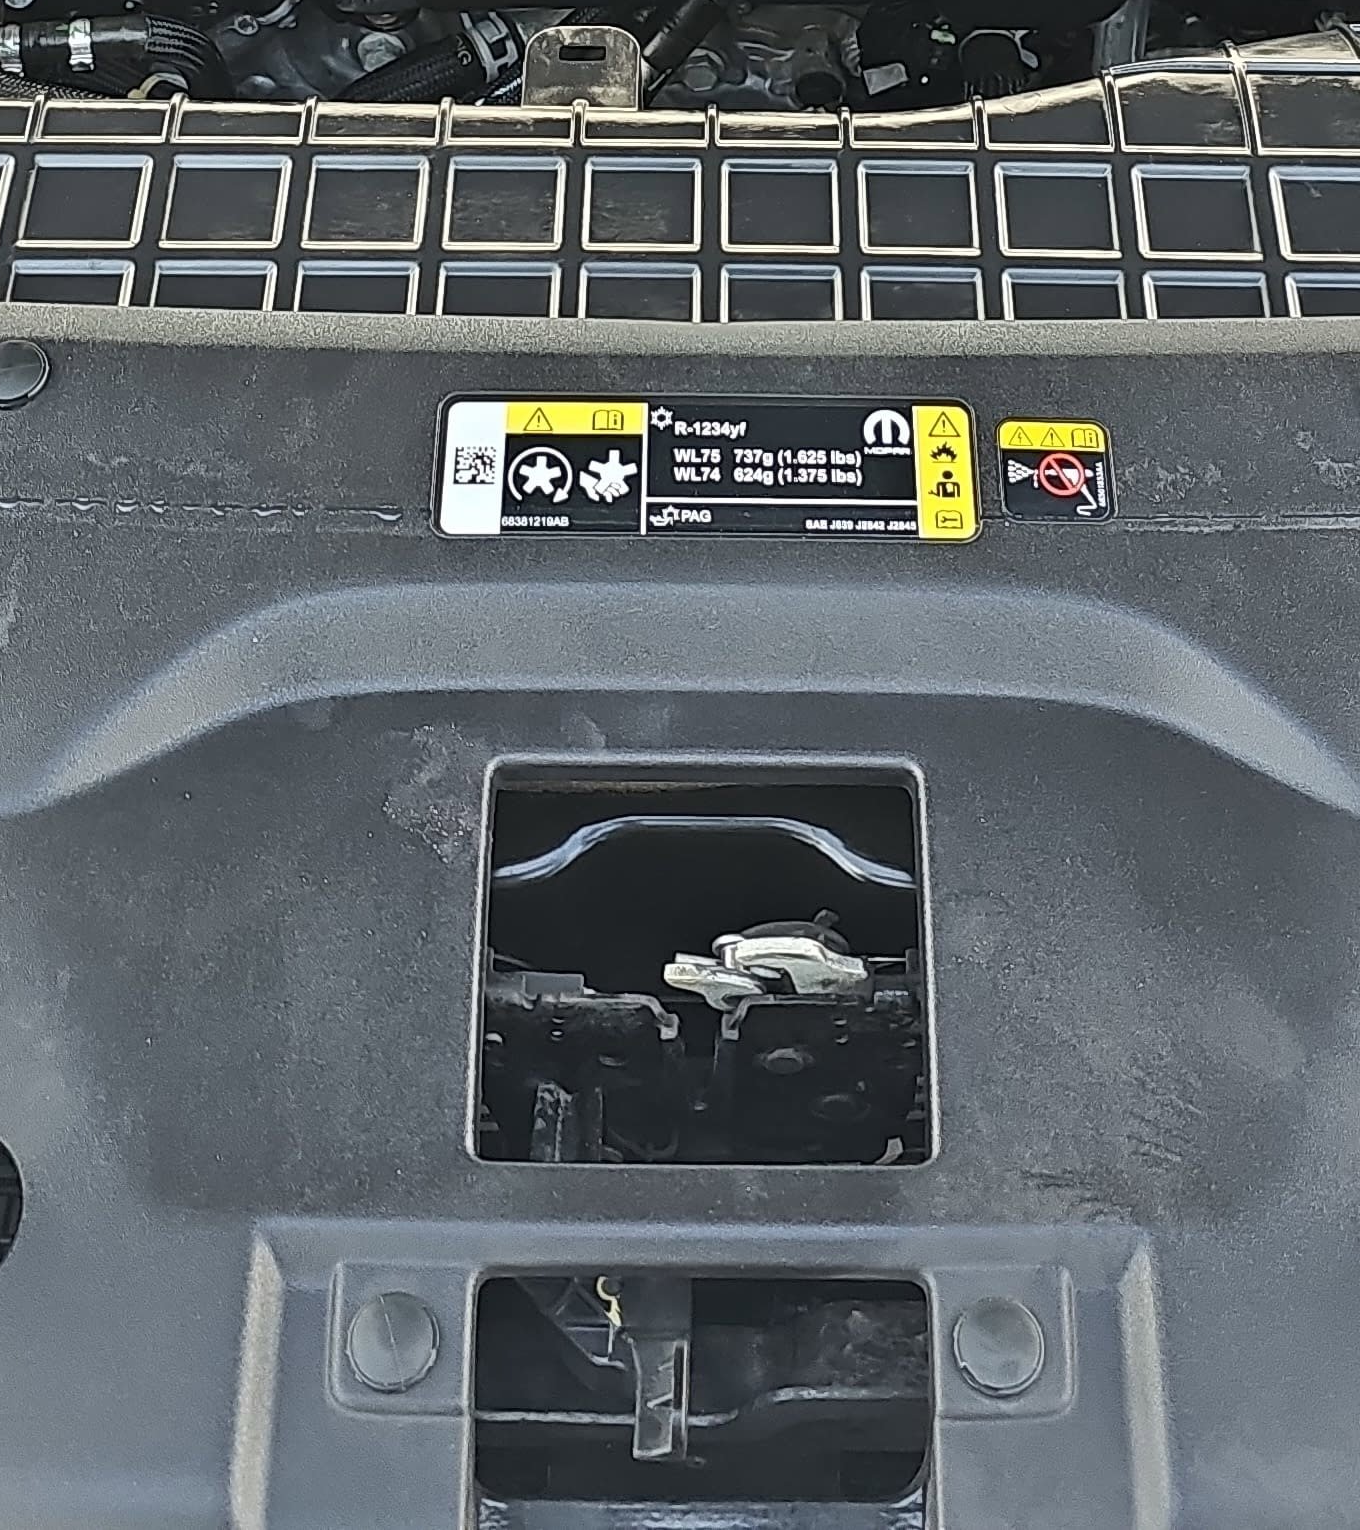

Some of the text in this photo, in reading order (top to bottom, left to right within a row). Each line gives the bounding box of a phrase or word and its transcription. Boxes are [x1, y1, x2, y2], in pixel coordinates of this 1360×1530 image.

[674, 421, 747, 439] R-1234yf
[673, 448, 862, 468] WL75 737g (1.625 lbs)
[864, 446, 912, 455] MOPAR
[673, 467, 863, 486] WL74 624g (1.375 lbs)
[681, 509, 712, 523] PAG
